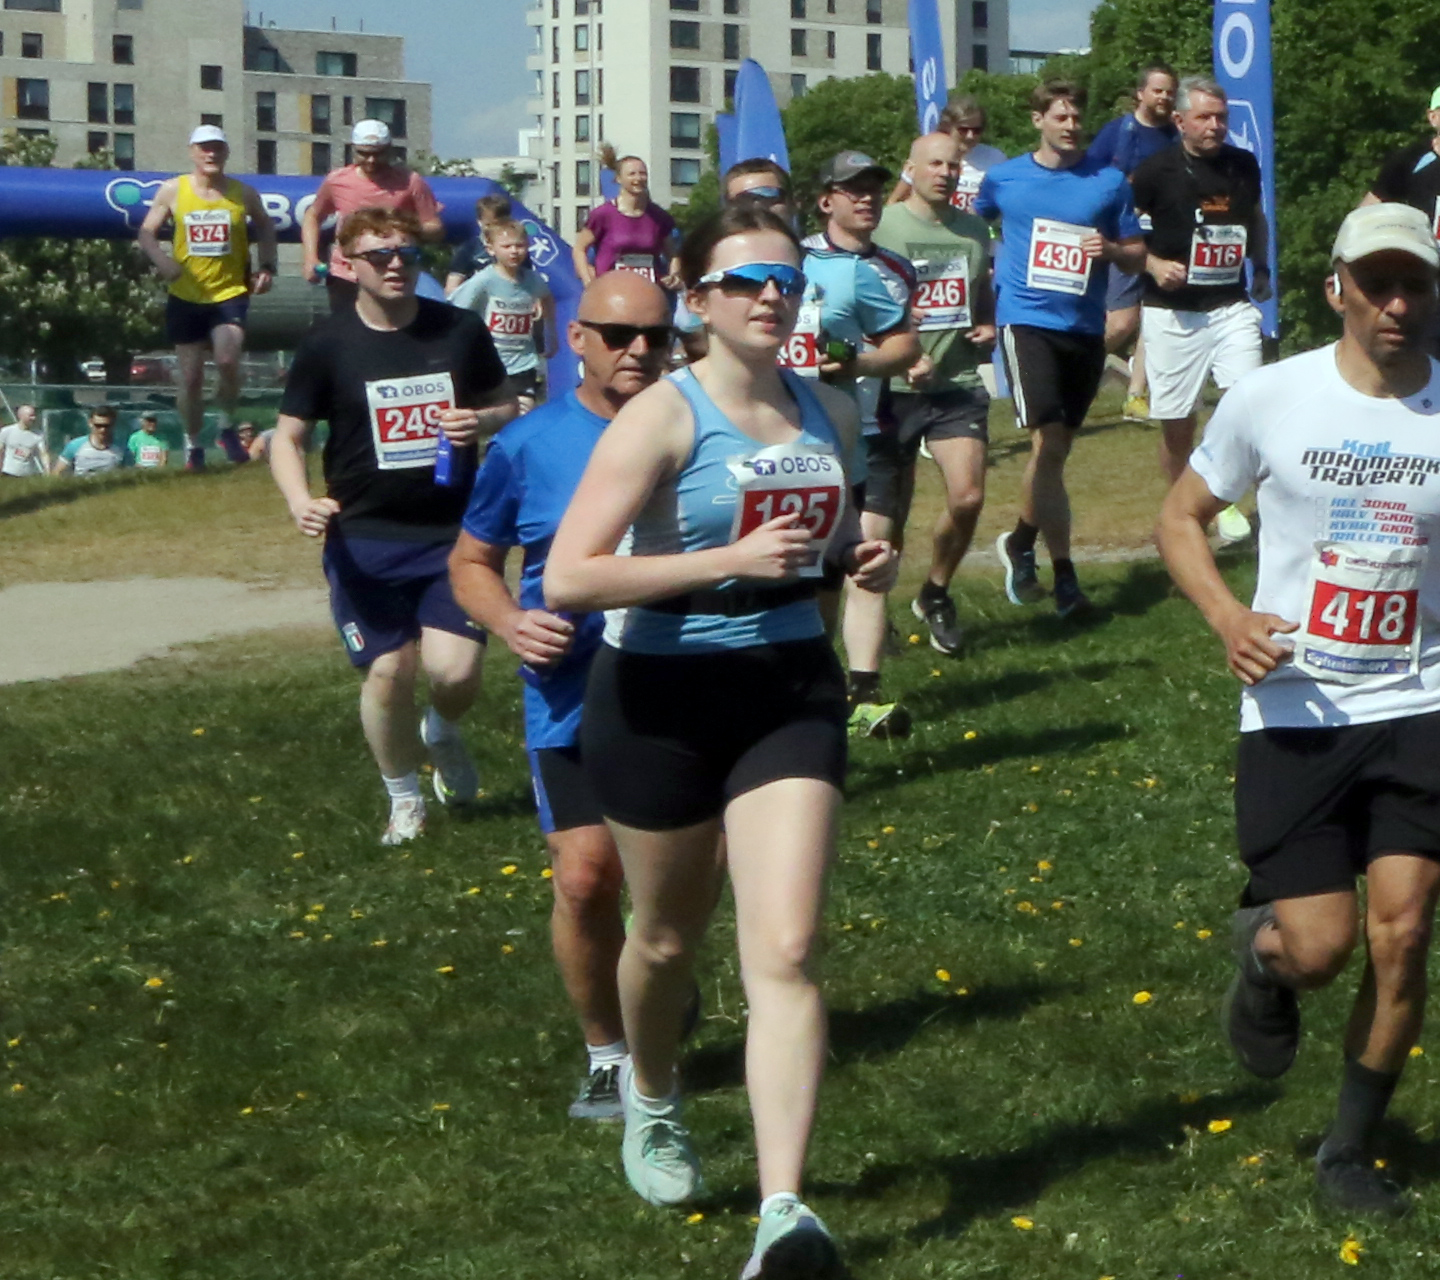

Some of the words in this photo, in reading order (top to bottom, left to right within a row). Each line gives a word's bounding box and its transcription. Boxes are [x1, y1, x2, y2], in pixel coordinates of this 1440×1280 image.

[193, 225, 225, 242] 374
[1039, 244, 1083, 271] 430
[1202, 245, 1237, 266] 116
[917, 280, 960, 307] 246
[402, 382, 445, 397] OBOS
[385, 404, 441, 440] 249
[780, 457, 832, 474] OBOS
[1320, 590, 1408, 641] 418
